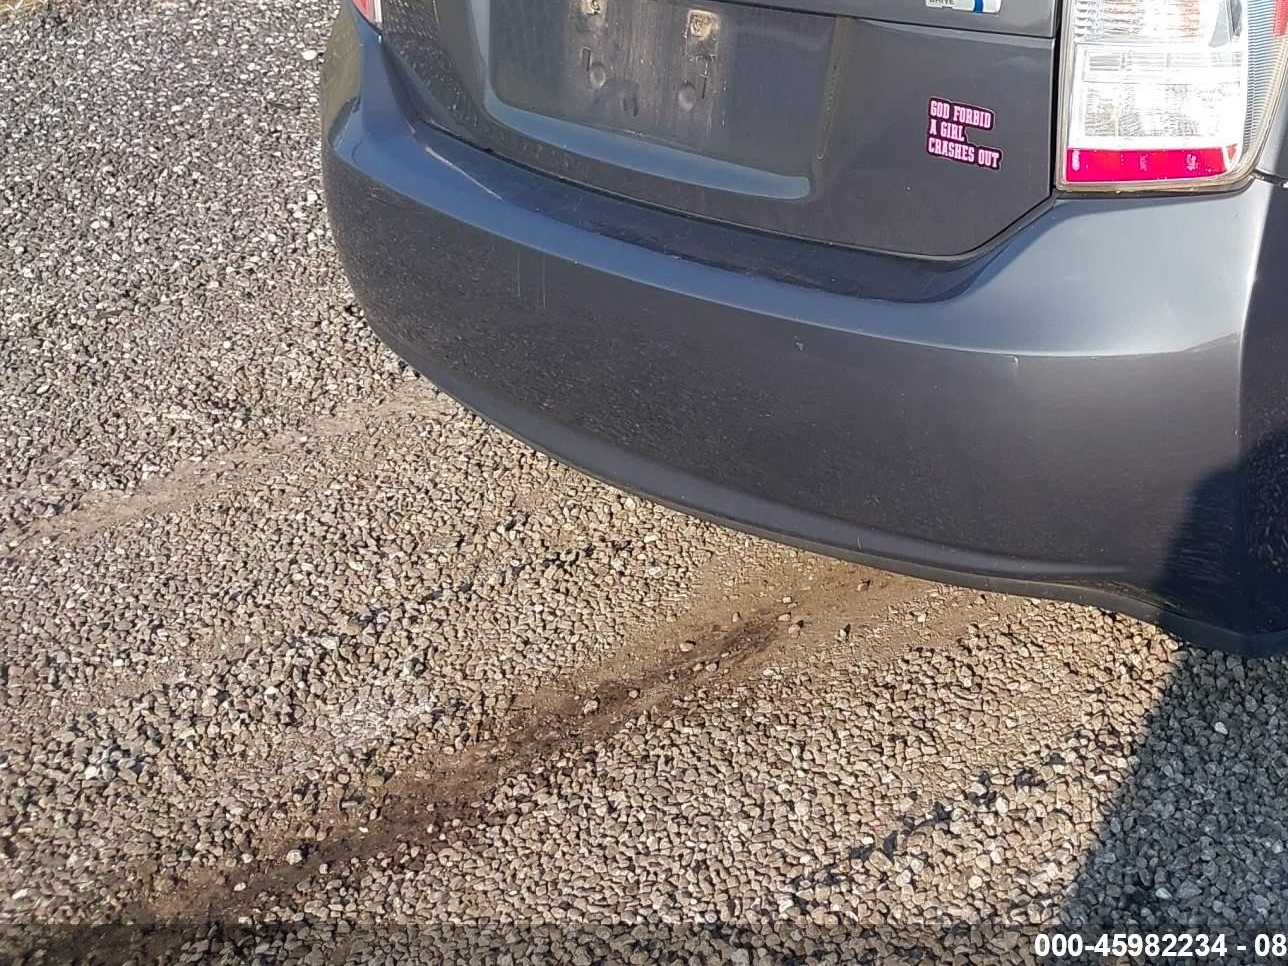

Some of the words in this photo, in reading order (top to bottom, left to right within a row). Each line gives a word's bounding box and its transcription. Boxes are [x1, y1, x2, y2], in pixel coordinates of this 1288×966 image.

[930, 100, 950, 119] GOD
[953, 105, 992, 129] FORBID
[929, 118, 938, 136] A
[940, 121, 965, 142] GIRL
[928, 137, 975, 163] CRASHES
[978, 149, 1000, 168] OUT
